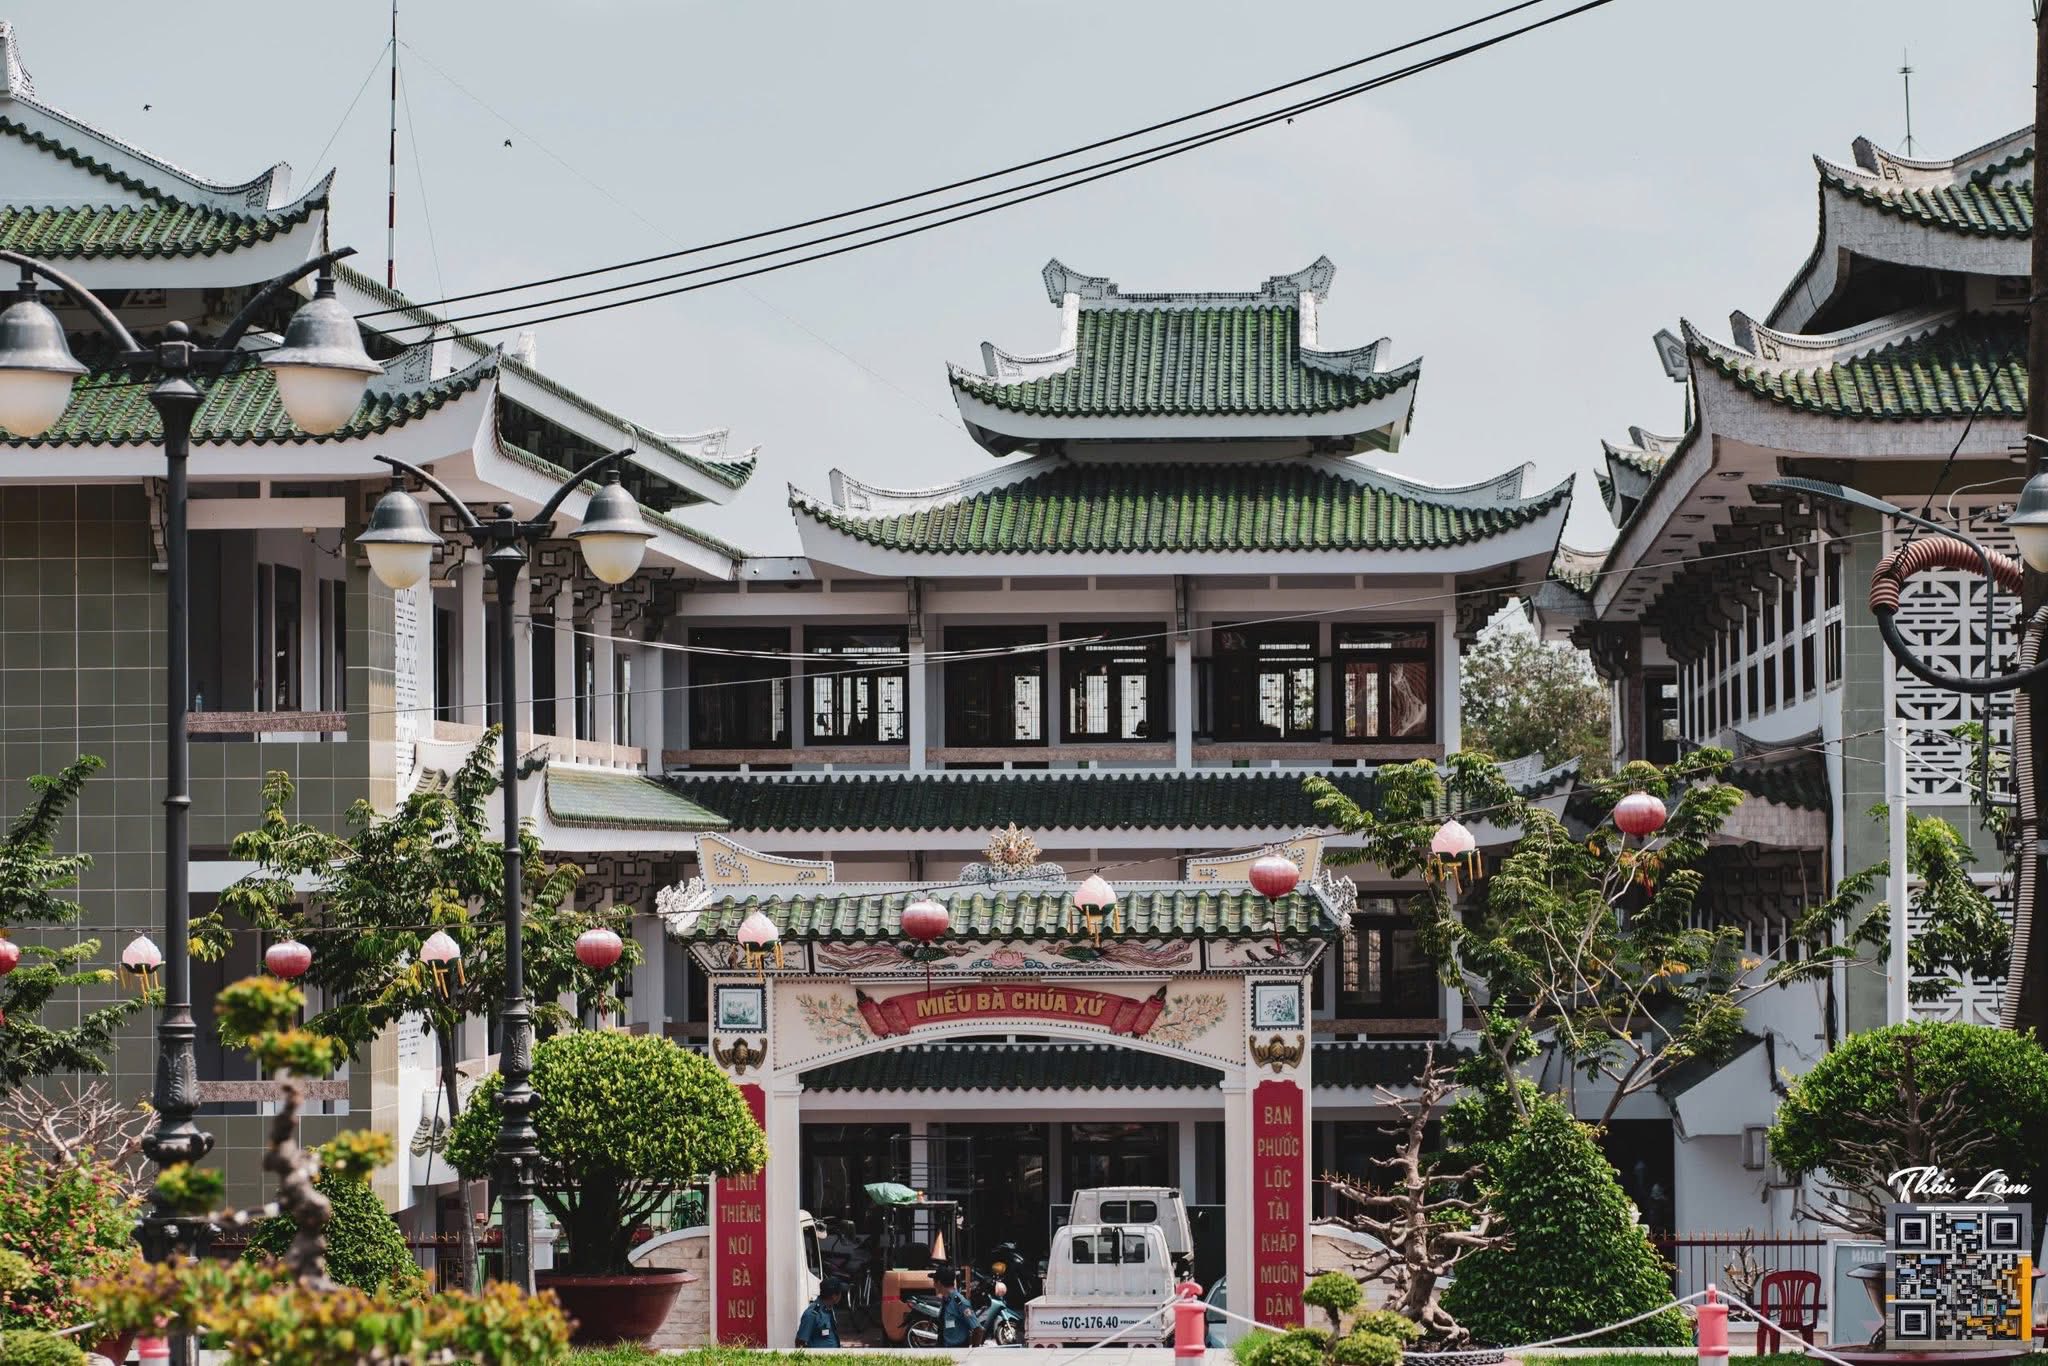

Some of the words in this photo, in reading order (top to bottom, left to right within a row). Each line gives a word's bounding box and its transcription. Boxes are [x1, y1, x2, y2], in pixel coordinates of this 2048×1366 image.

[916, 988, 972, 1017] MIẾU
[977, 986, 1006, 1011] BÀ
[1011, 988, 1067, 1012] CHÚA
[1073, 993, 1106, 1017] XỨ
[1264, 1105, 1292, 1125] BAN
[1257, 1132, 1299, 1157] PHƯỚC
[1264, 1165, 1292, 1191] LỘC
[721, 1200, 761, 1223] THIÊNG
[1267, 1195, 1289, 1220] TÀI
[728, 1234, 752, 1255] NƠI
[732, 1262, 752, 1287] BÀ
[1261, 1261, 1298, 1284] MUÔN
[1265, 1293, 1293, 1316] DÂN
[1061, 1315, 1119, 1329] 67C-176.40
